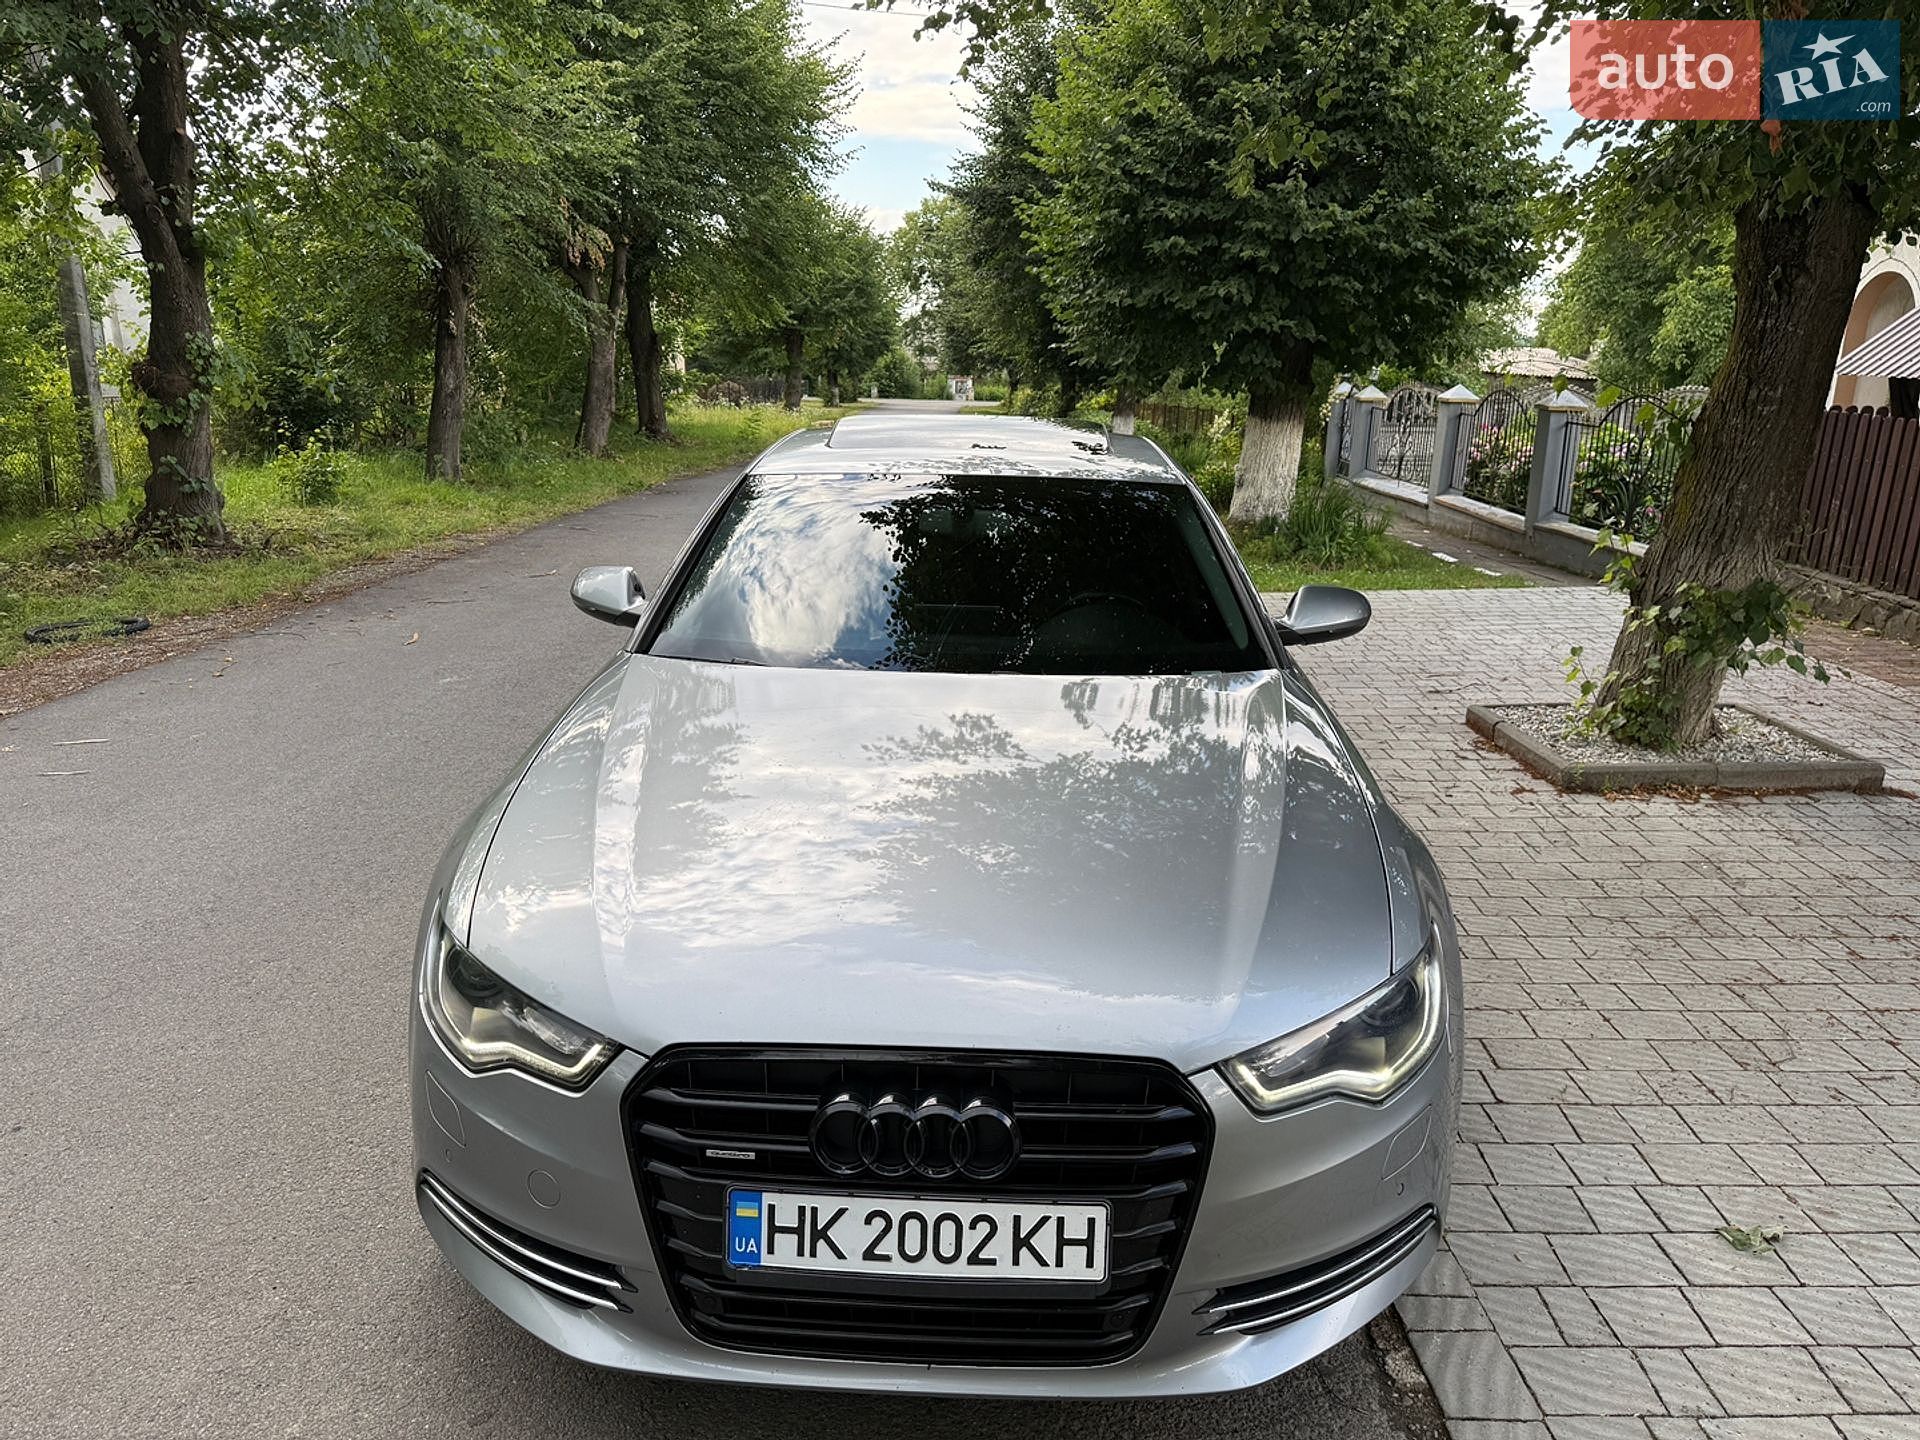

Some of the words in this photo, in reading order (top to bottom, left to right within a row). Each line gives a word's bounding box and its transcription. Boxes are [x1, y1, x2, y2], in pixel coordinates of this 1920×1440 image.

[735, 1236, 757, 1254] UA
[766, 1203, 849, 1260] HK
[862, 1209, 998, 1266] 2002
[1011, 1214, 1096, 1269] KH
